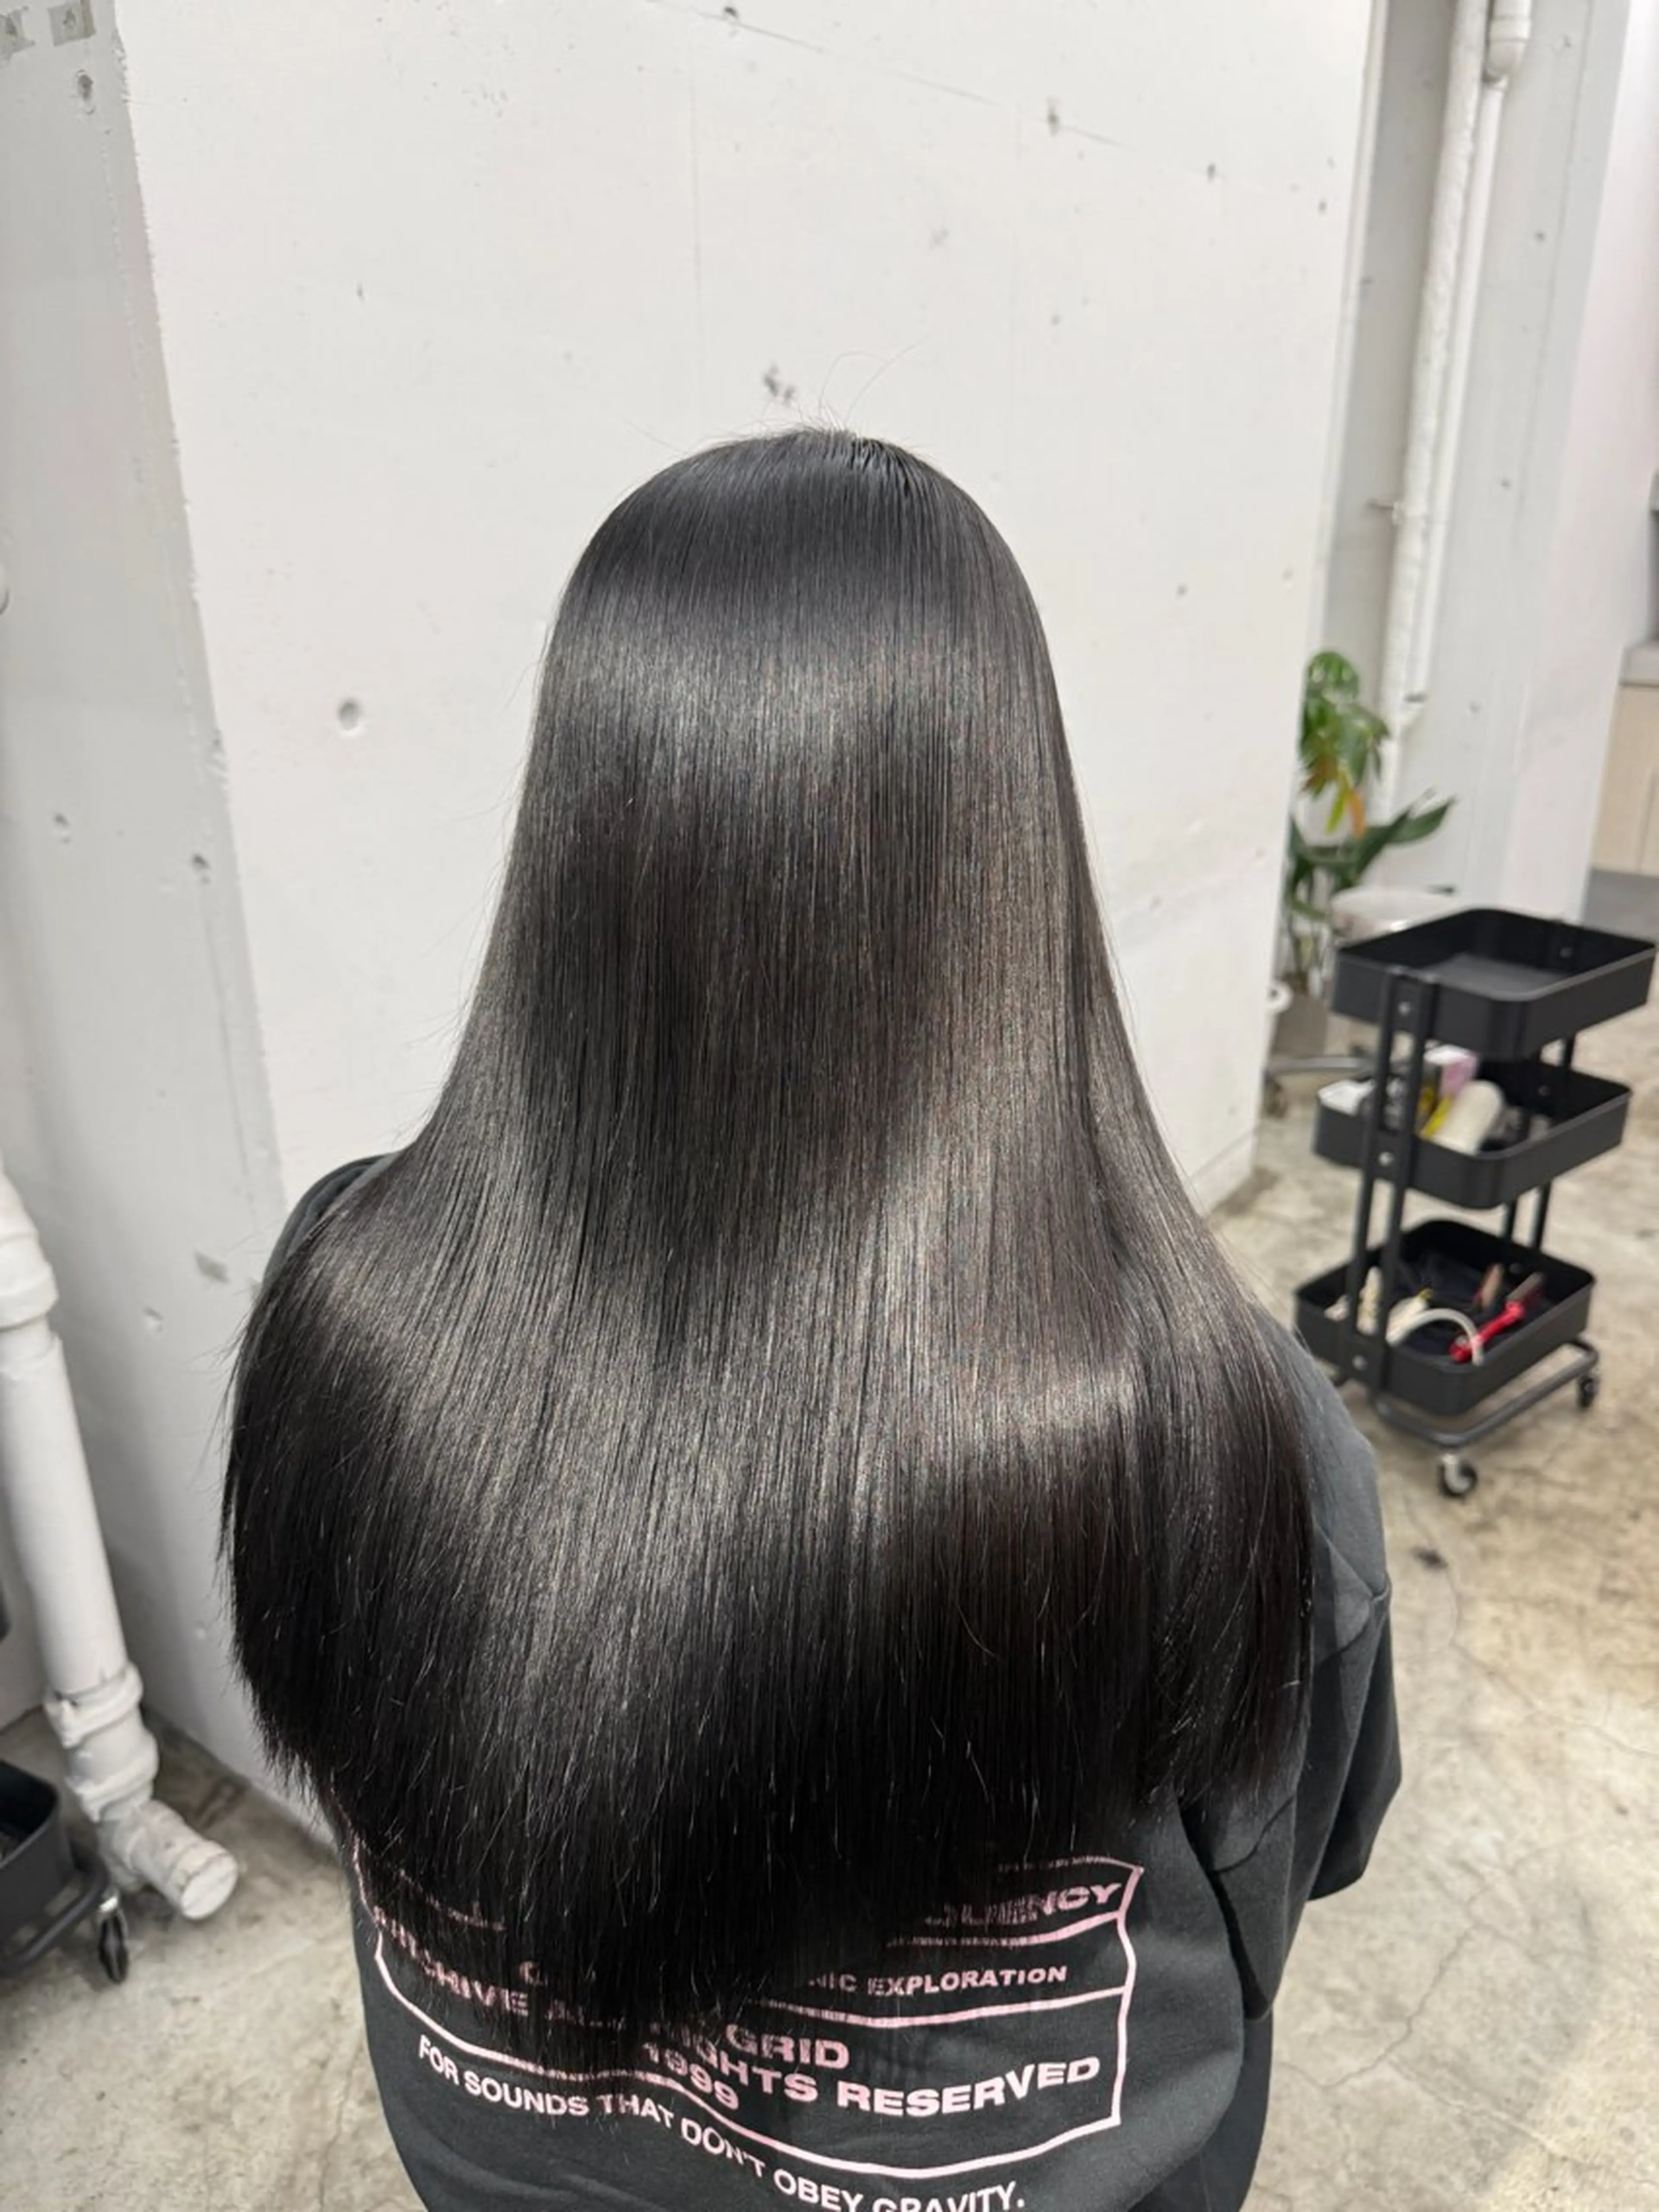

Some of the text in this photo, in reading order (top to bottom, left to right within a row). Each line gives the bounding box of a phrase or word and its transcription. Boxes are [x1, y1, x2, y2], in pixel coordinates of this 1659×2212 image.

[868, 1965, 1068, 1997] EXPLORATION
[643, 2041, 739, 2110] 1999
[726, 2024, 849, 2069] GRID
[837, 2056, 1100, 2117] RESERVED
[418, 2034, 1025, 2212] FOR SOUNDS THAT DON'T OBEY GRAVITY.
